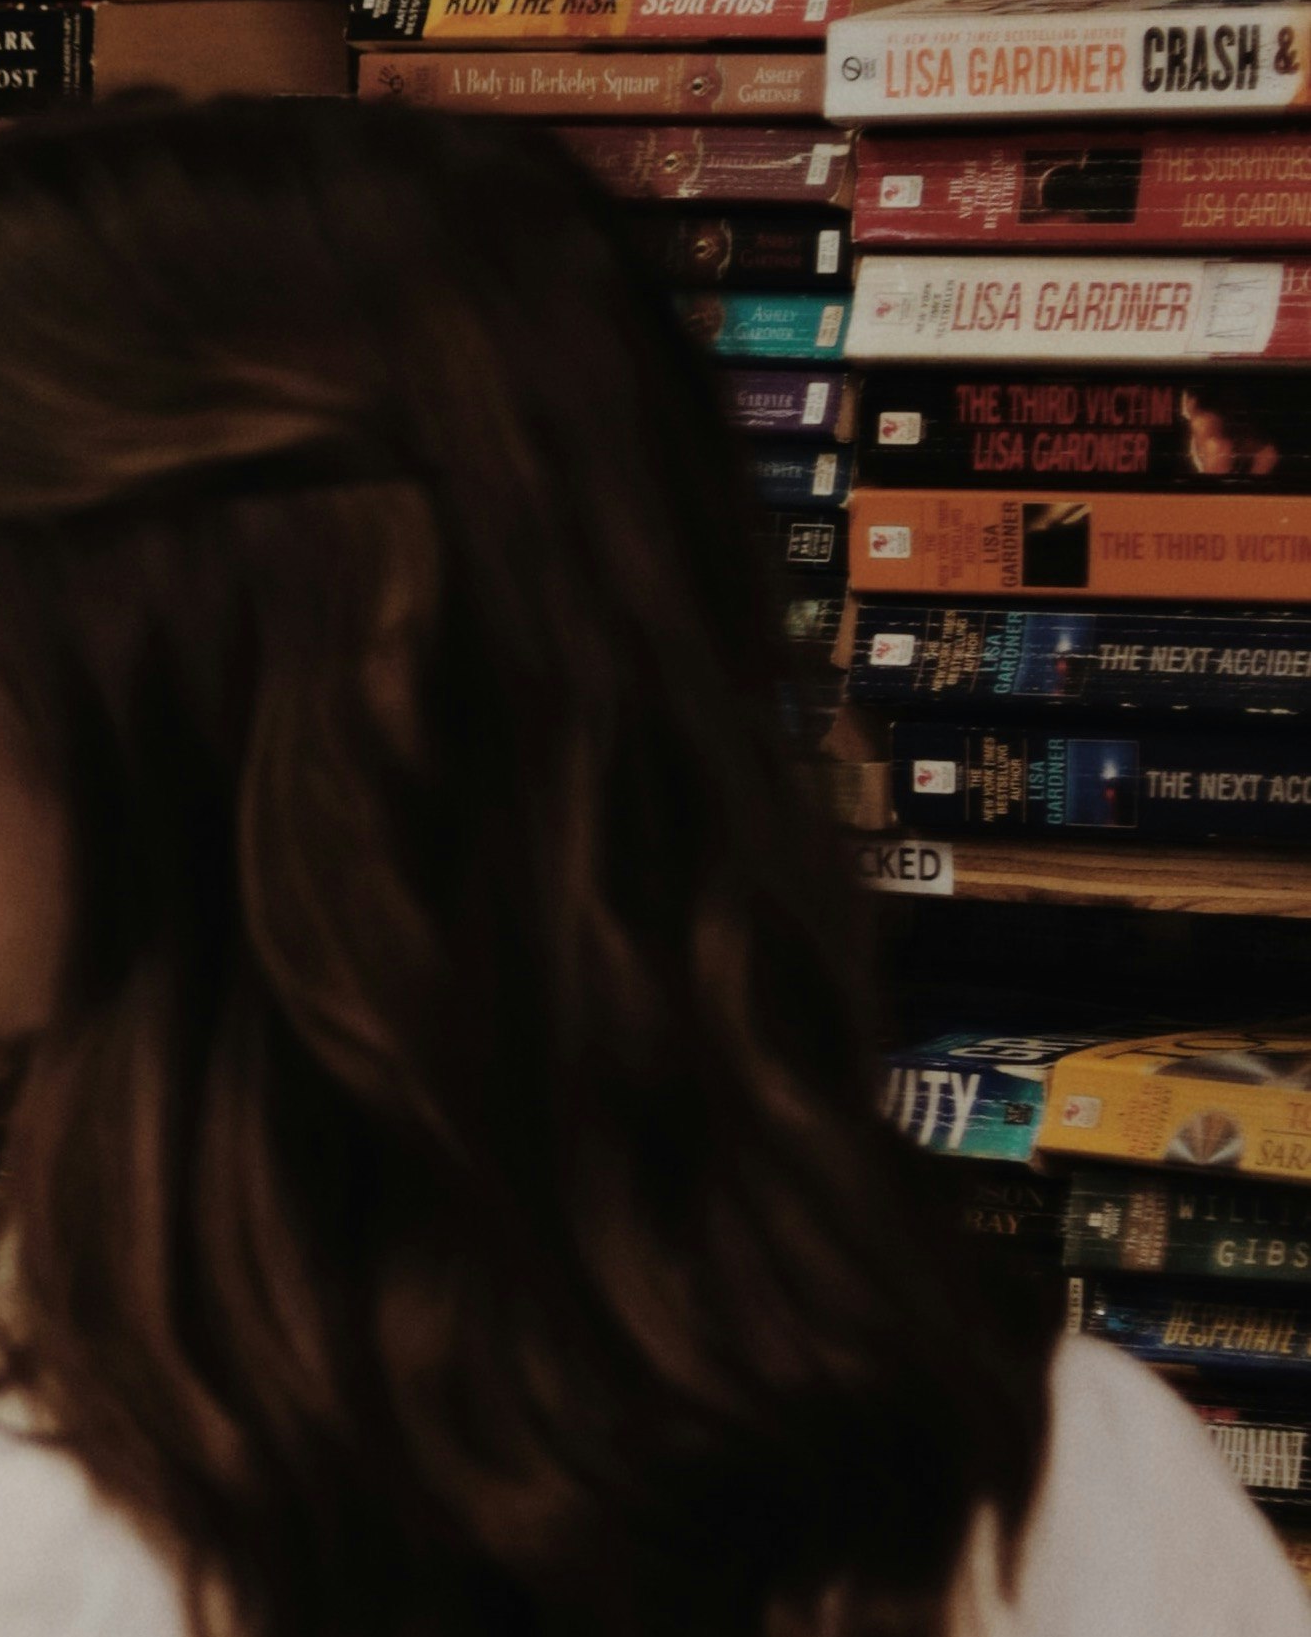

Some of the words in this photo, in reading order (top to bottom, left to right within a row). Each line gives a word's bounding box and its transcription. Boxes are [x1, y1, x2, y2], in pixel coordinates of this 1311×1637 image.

[449, 68, 465, 96] A
[465, 67, 505, 100] Body
[506, 69, 528, 95] in
[528, 67, 599, 100] Berkeley
[599, 67, 662, 99] Square
[884, 50, 957, 99] LISA
[967, 42, 1127, 98] GARDNER
[1140, 24, 1262, 93] CRASH
[1272, 26, 1301, 75] &
